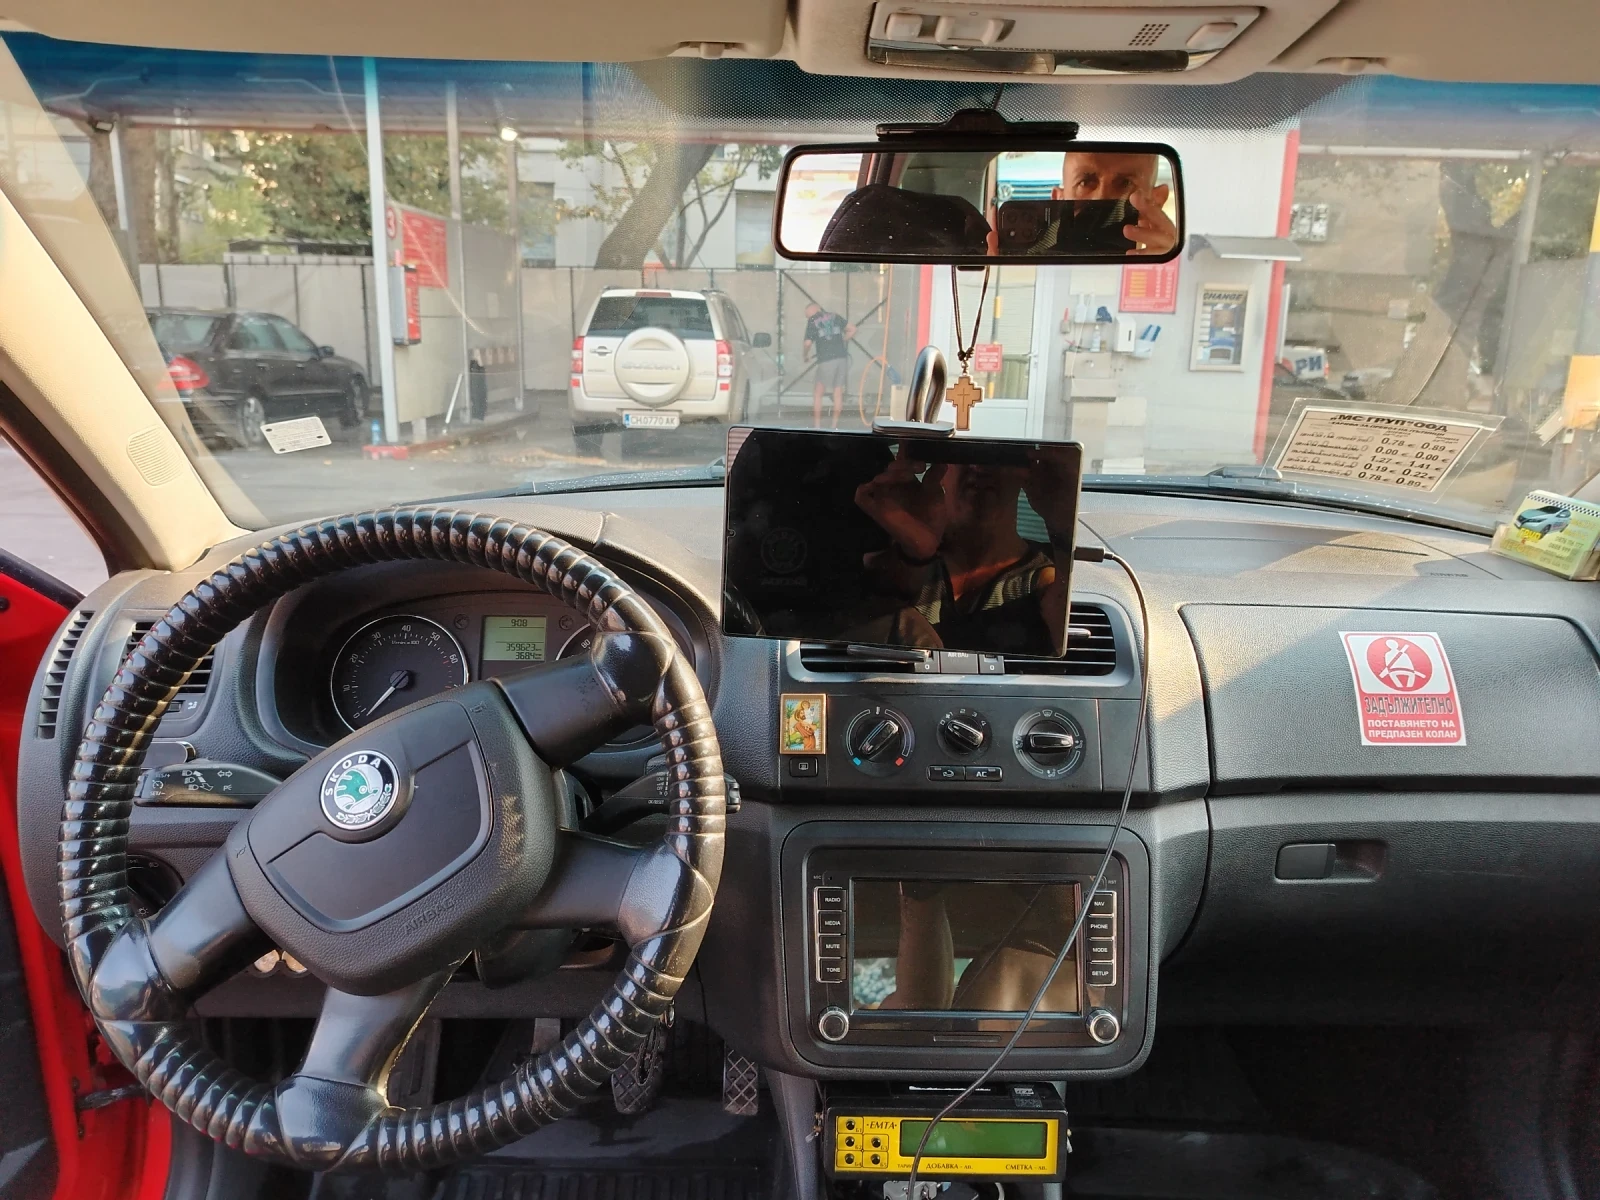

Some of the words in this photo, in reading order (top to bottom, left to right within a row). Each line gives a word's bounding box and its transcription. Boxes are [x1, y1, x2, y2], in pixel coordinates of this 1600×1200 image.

[1203, 292, 1243, 300] CHANGE
[1381, 437, 1405, 446] 0.78
[1421, 442, 1446, 452] 0.89
[1375, 446, 1398, 455] 0.00
[1415, 451, 1439, 461] 0.00
[1370, 455, 1392, 464] 1.27
[1409, 460, 1431, 470] 1.41
[1363, 463, 1388, 472] 0.19
[1402, 468, 1428, 478] 0.22
[1358, 471, 1382, 481] 0.78
[1396, 477, 1421, 487] 0.89
[510, 618, 527, 627] 9:08
[401, 624, 411, 632] 40
[371, 631, 381, 640] 30
[430, 631, 441, 641] 50
[506, 643, 535, 651] 359623
[581, 638, 590, 649] 80
[350, 653, 359, 663] 20
[449, 653, 458, 664] 60
[343, 684, 350, 692] 10
[1364, 697, 1453, 716] ЗАДЪЛЖИТЕЛНО
[1367, 719, 1439, 728] ПОСТАВЯНЕТО
[1441, 719, 1455, 728] НА
[1368, 730, 1423, 739] ПРЕДПАЗЕН
[1425, 730, 1457, 738] КОЛАН
[926, 1162, 959, 1170] ДОБАВКА
